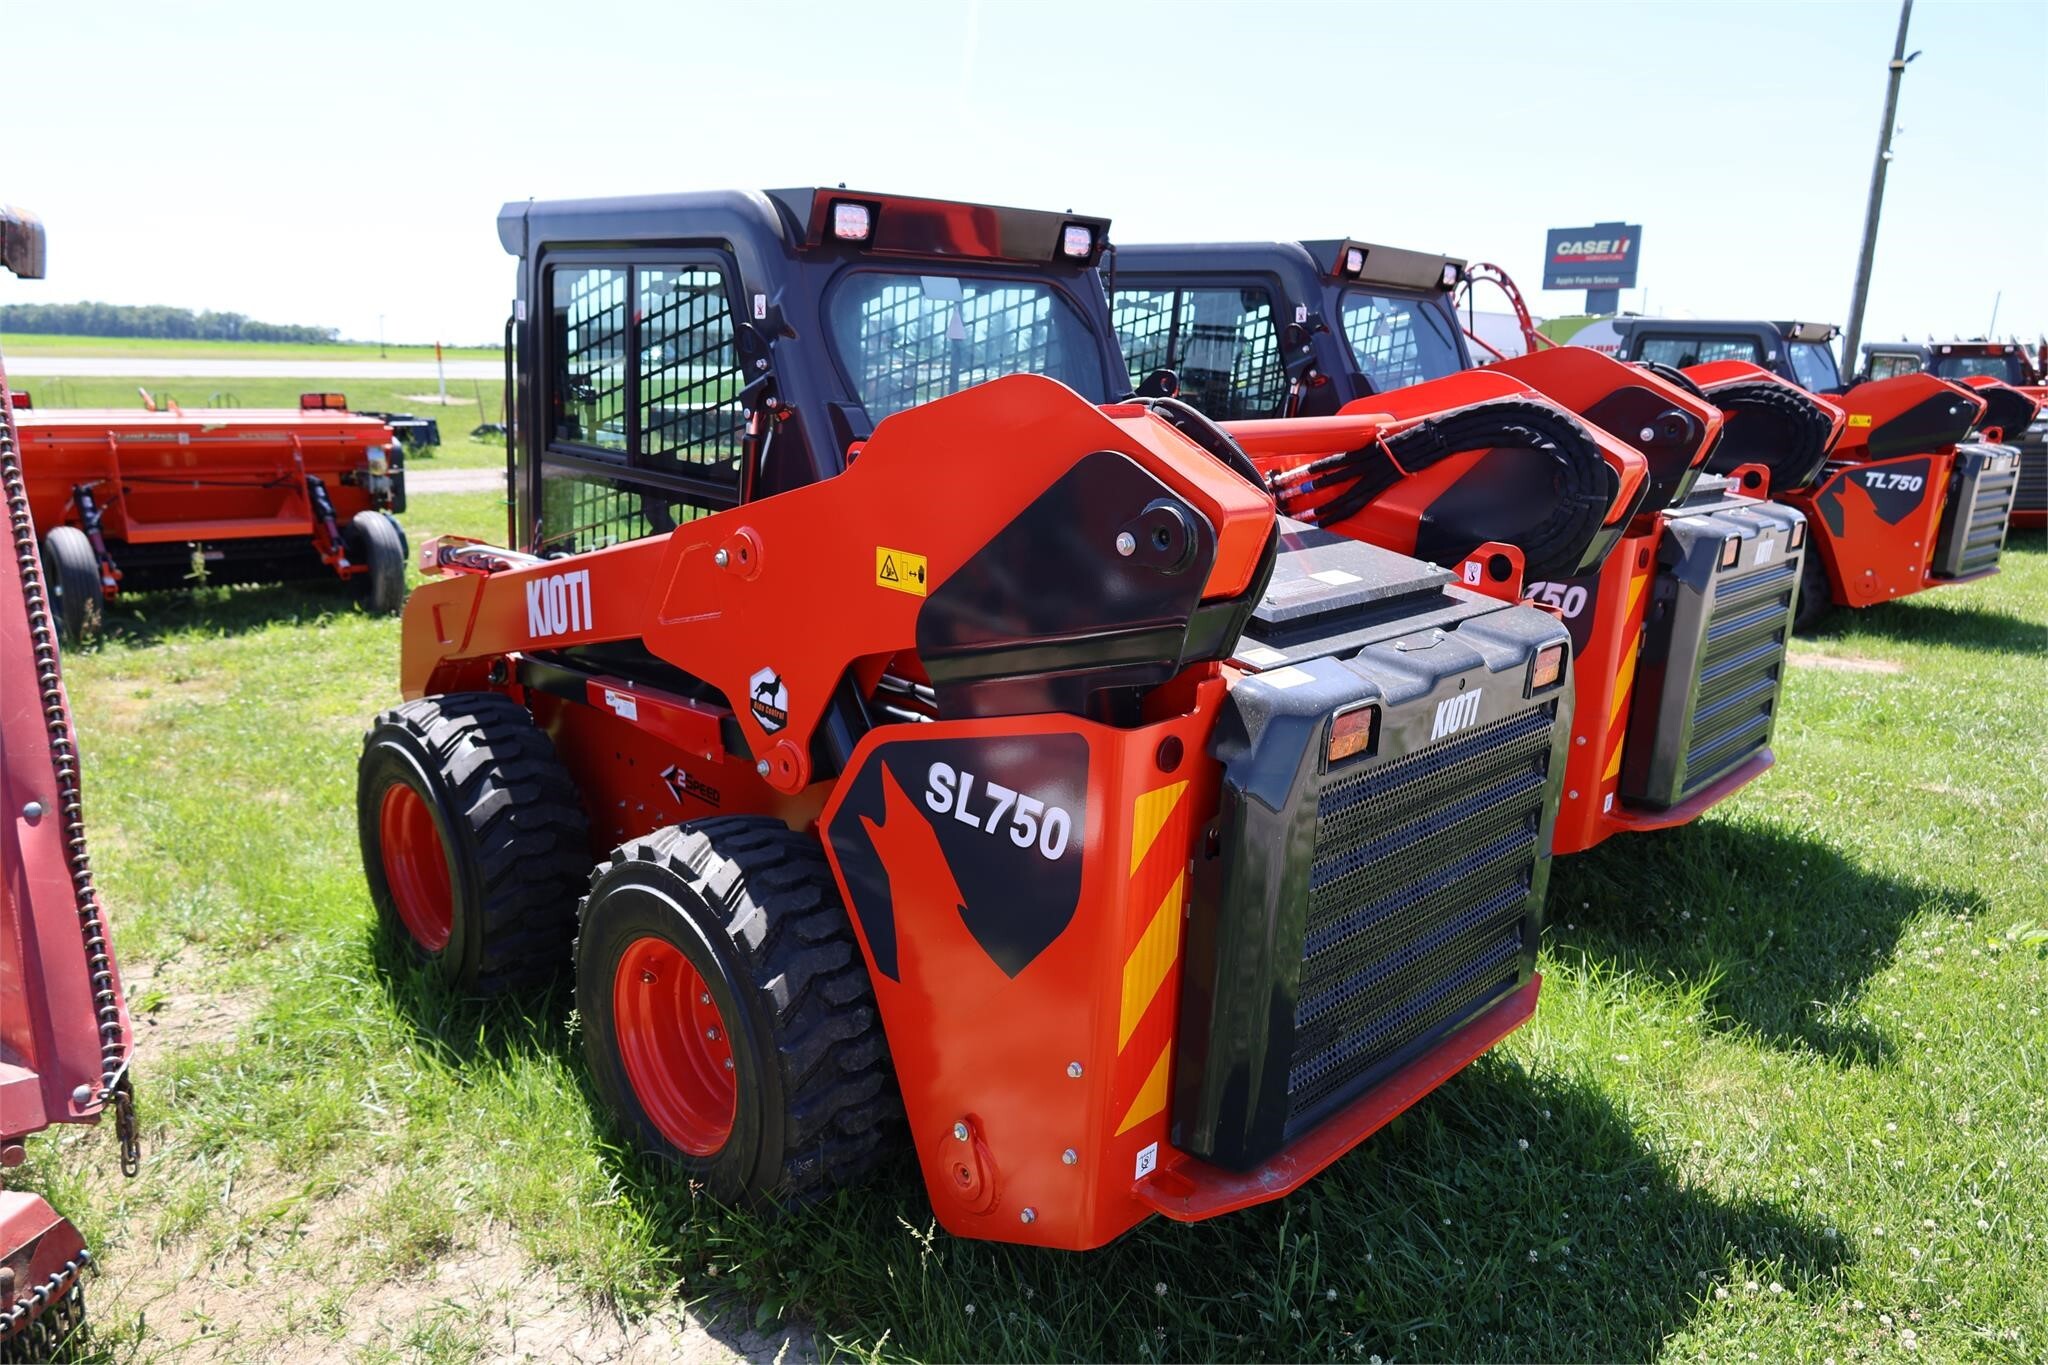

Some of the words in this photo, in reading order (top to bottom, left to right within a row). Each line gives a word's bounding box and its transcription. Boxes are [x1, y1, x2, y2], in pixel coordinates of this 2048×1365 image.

[1556, 240, 1610, 255] CASE
[1865, 471, 1923, 492] TL750
[526, 569, 593, 638] KIOTI
[1431, 688, 1482, 741] KIOTI
[925, 762, 1072, 861] SL750
